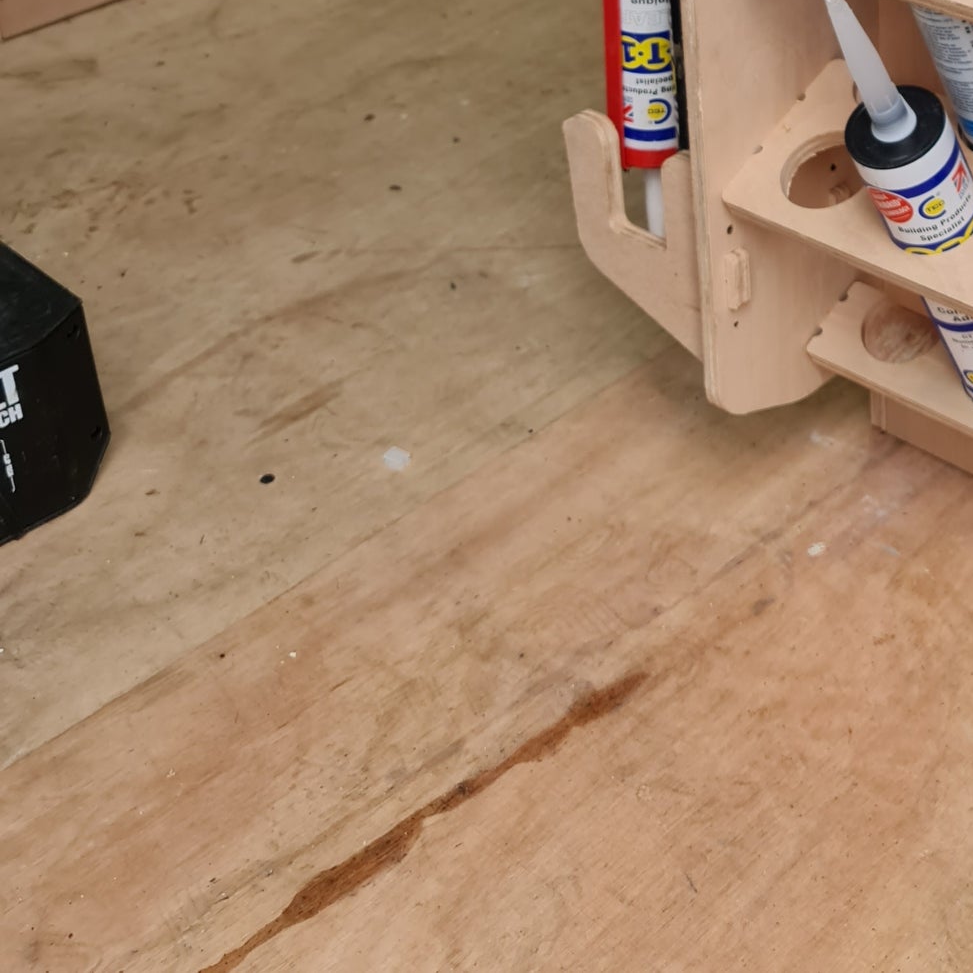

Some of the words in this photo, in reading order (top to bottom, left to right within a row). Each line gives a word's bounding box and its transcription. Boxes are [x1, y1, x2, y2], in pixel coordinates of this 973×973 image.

[898, 224, 938, 234] Building
[940, 194, 972, 226] Products
[920, 216, 965, 242] Specialist
